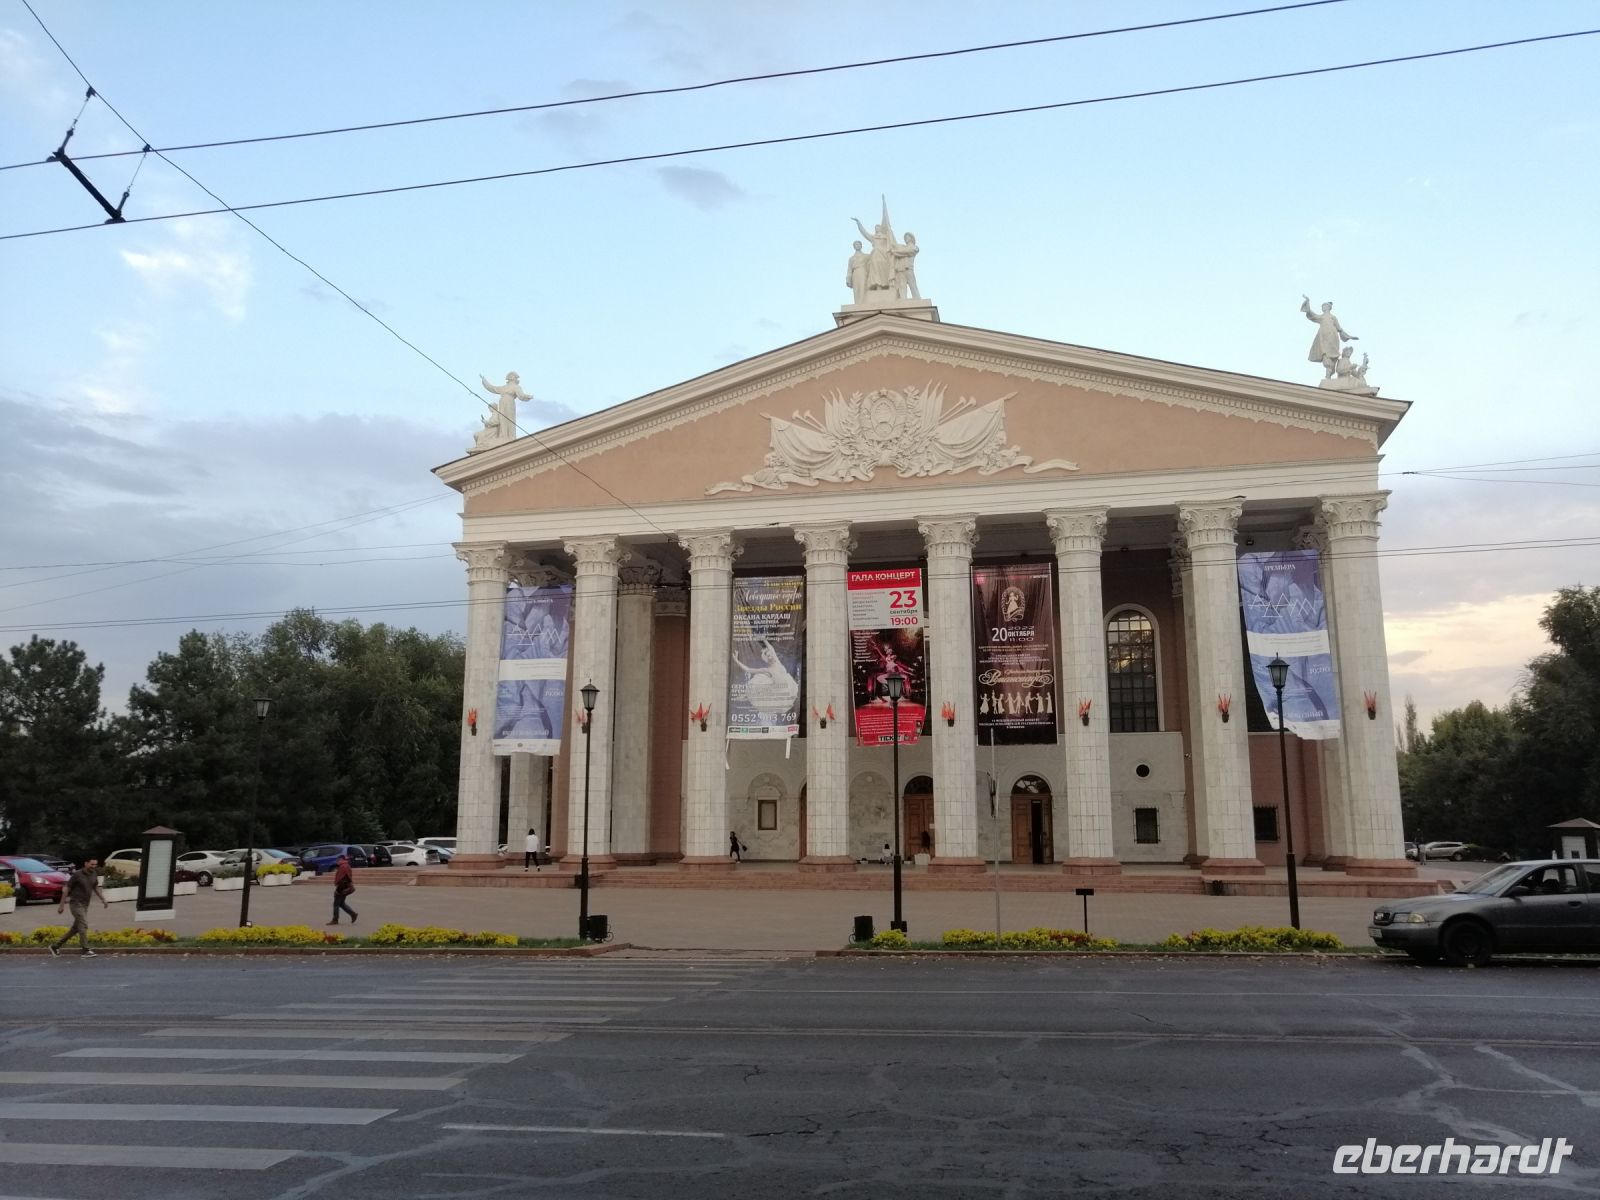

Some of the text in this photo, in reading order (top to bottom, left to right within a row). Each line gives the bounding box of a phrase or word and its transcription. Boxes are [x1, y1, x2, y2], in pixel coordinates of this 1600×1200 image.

[851, 571, 916, 582] ГАЛА КОНЦЕРТ
[889, 590, 917, 609] 23
[890, 616, 918, 626] 19:00
[991, 627, 1008, 642] 20
[731, 713, 757, 723] 0552
[781, 712, 797, 722] 769
